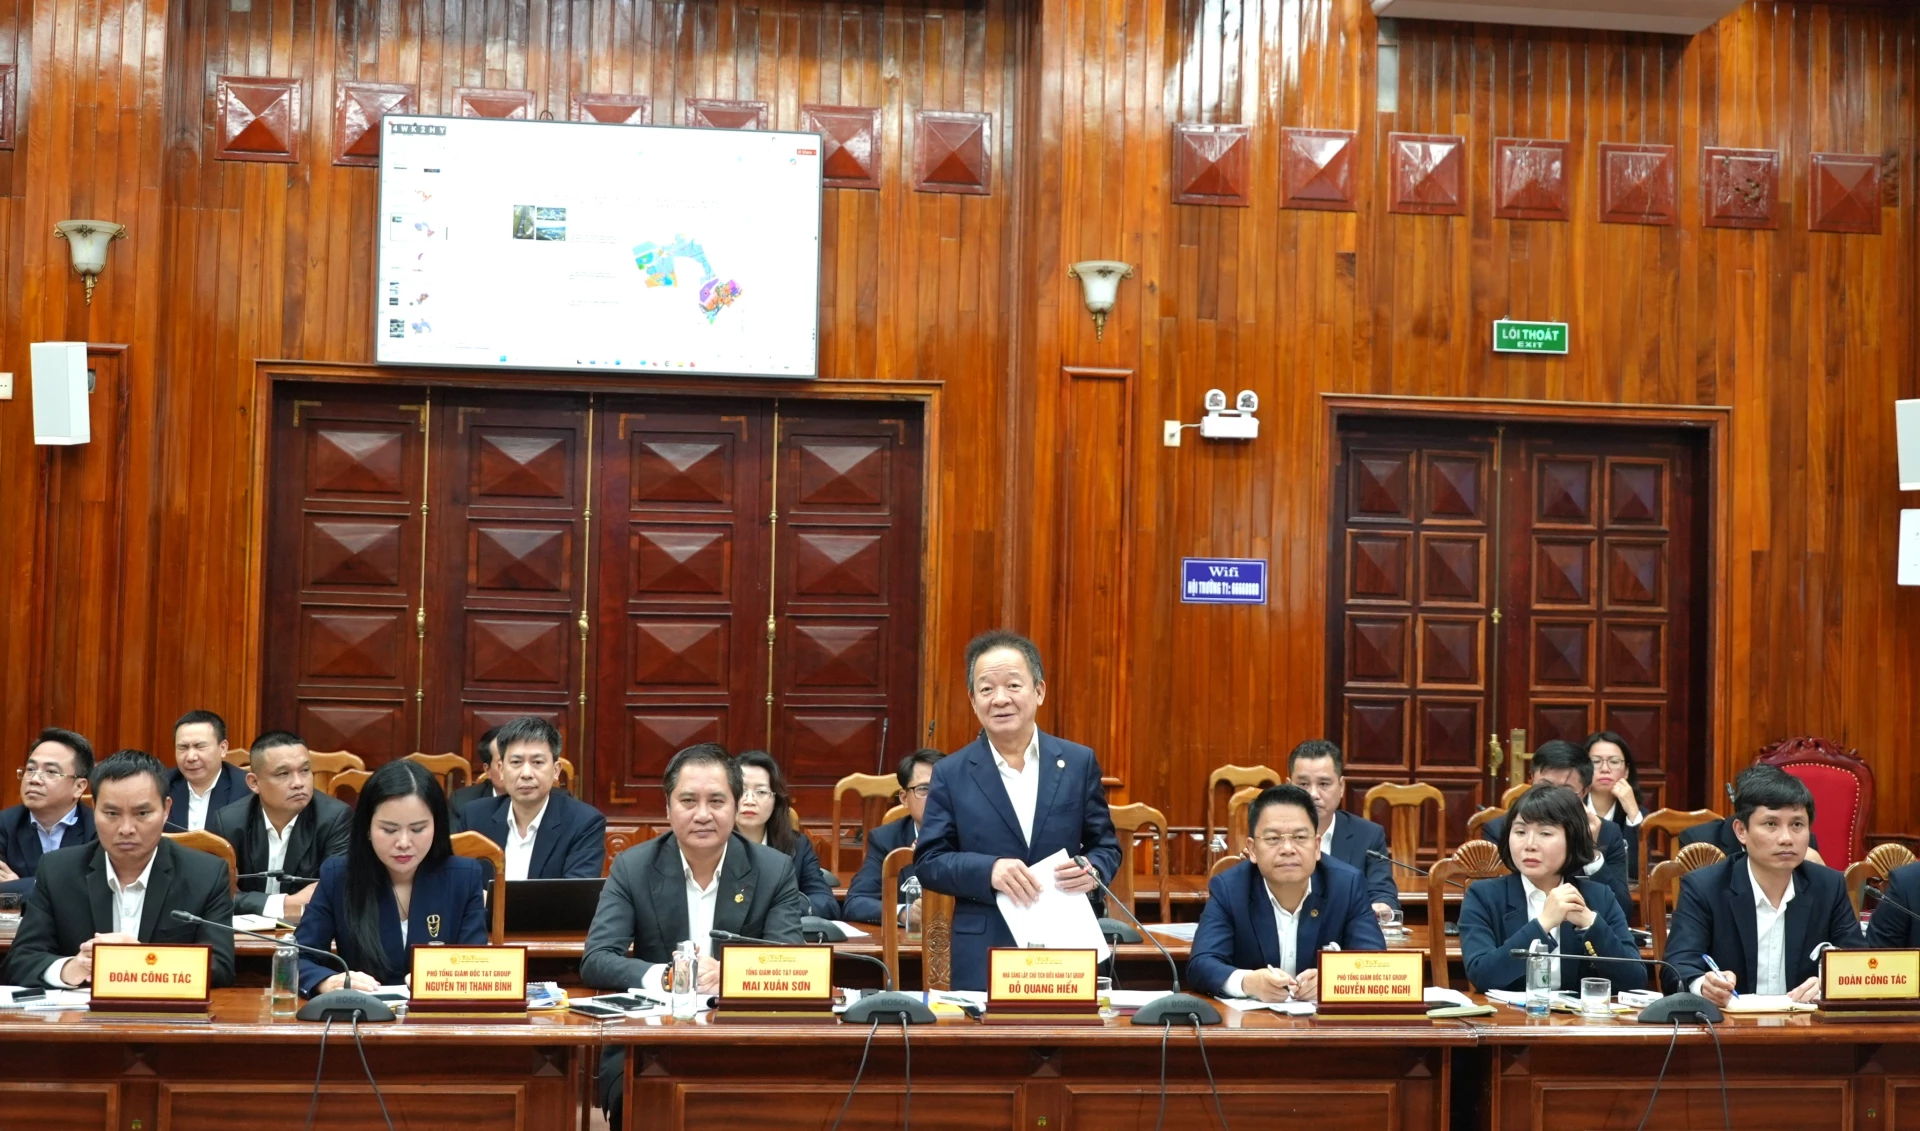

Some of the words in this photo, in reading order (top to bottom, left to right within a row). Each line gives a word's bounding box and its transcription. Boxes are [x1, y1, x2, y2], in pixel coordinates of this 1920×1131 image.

[1521, 327, 1560, 341] THOÁT
[1516, 340, 1544, 349] EXIT
[1208, 566, 1240, 577] Wifi
[109, 969, 138, 983] ĐOÀN
[141, 970, 169, 984] CÔNG
[172, 970, 192, 984] TÁC
[1838, 973, 1863, 986] ĐOÀN
[1864, 973, 1889, 986] CÔNG
[1890, 973, 1907, 985] TÁC
[425, 978, 455, 992] NGUYỄN
[456, 981, 468, 994] THỊ
[469, 981, 493, 992] THANH
[742, 981, 761, 991] MAI
[763, 978, 789, 991] XUÂN
[791, 980, 811, 991] SƠN
[1023, 983, 1054, 994] QUANG
[1056, 979, 1078, 994] HIỂN
[1333, 982, 1366, 995] NGUYỄN
[1367, 984, 1390, 997] NGỌC
[1391, 984, 1411, 997] NGHỊ
[335, 996, 367, 1005] BOSCH
[881, 998, 911, 1006] BOSCH
[1171, 1000, 1199, 1008] BOSCH
